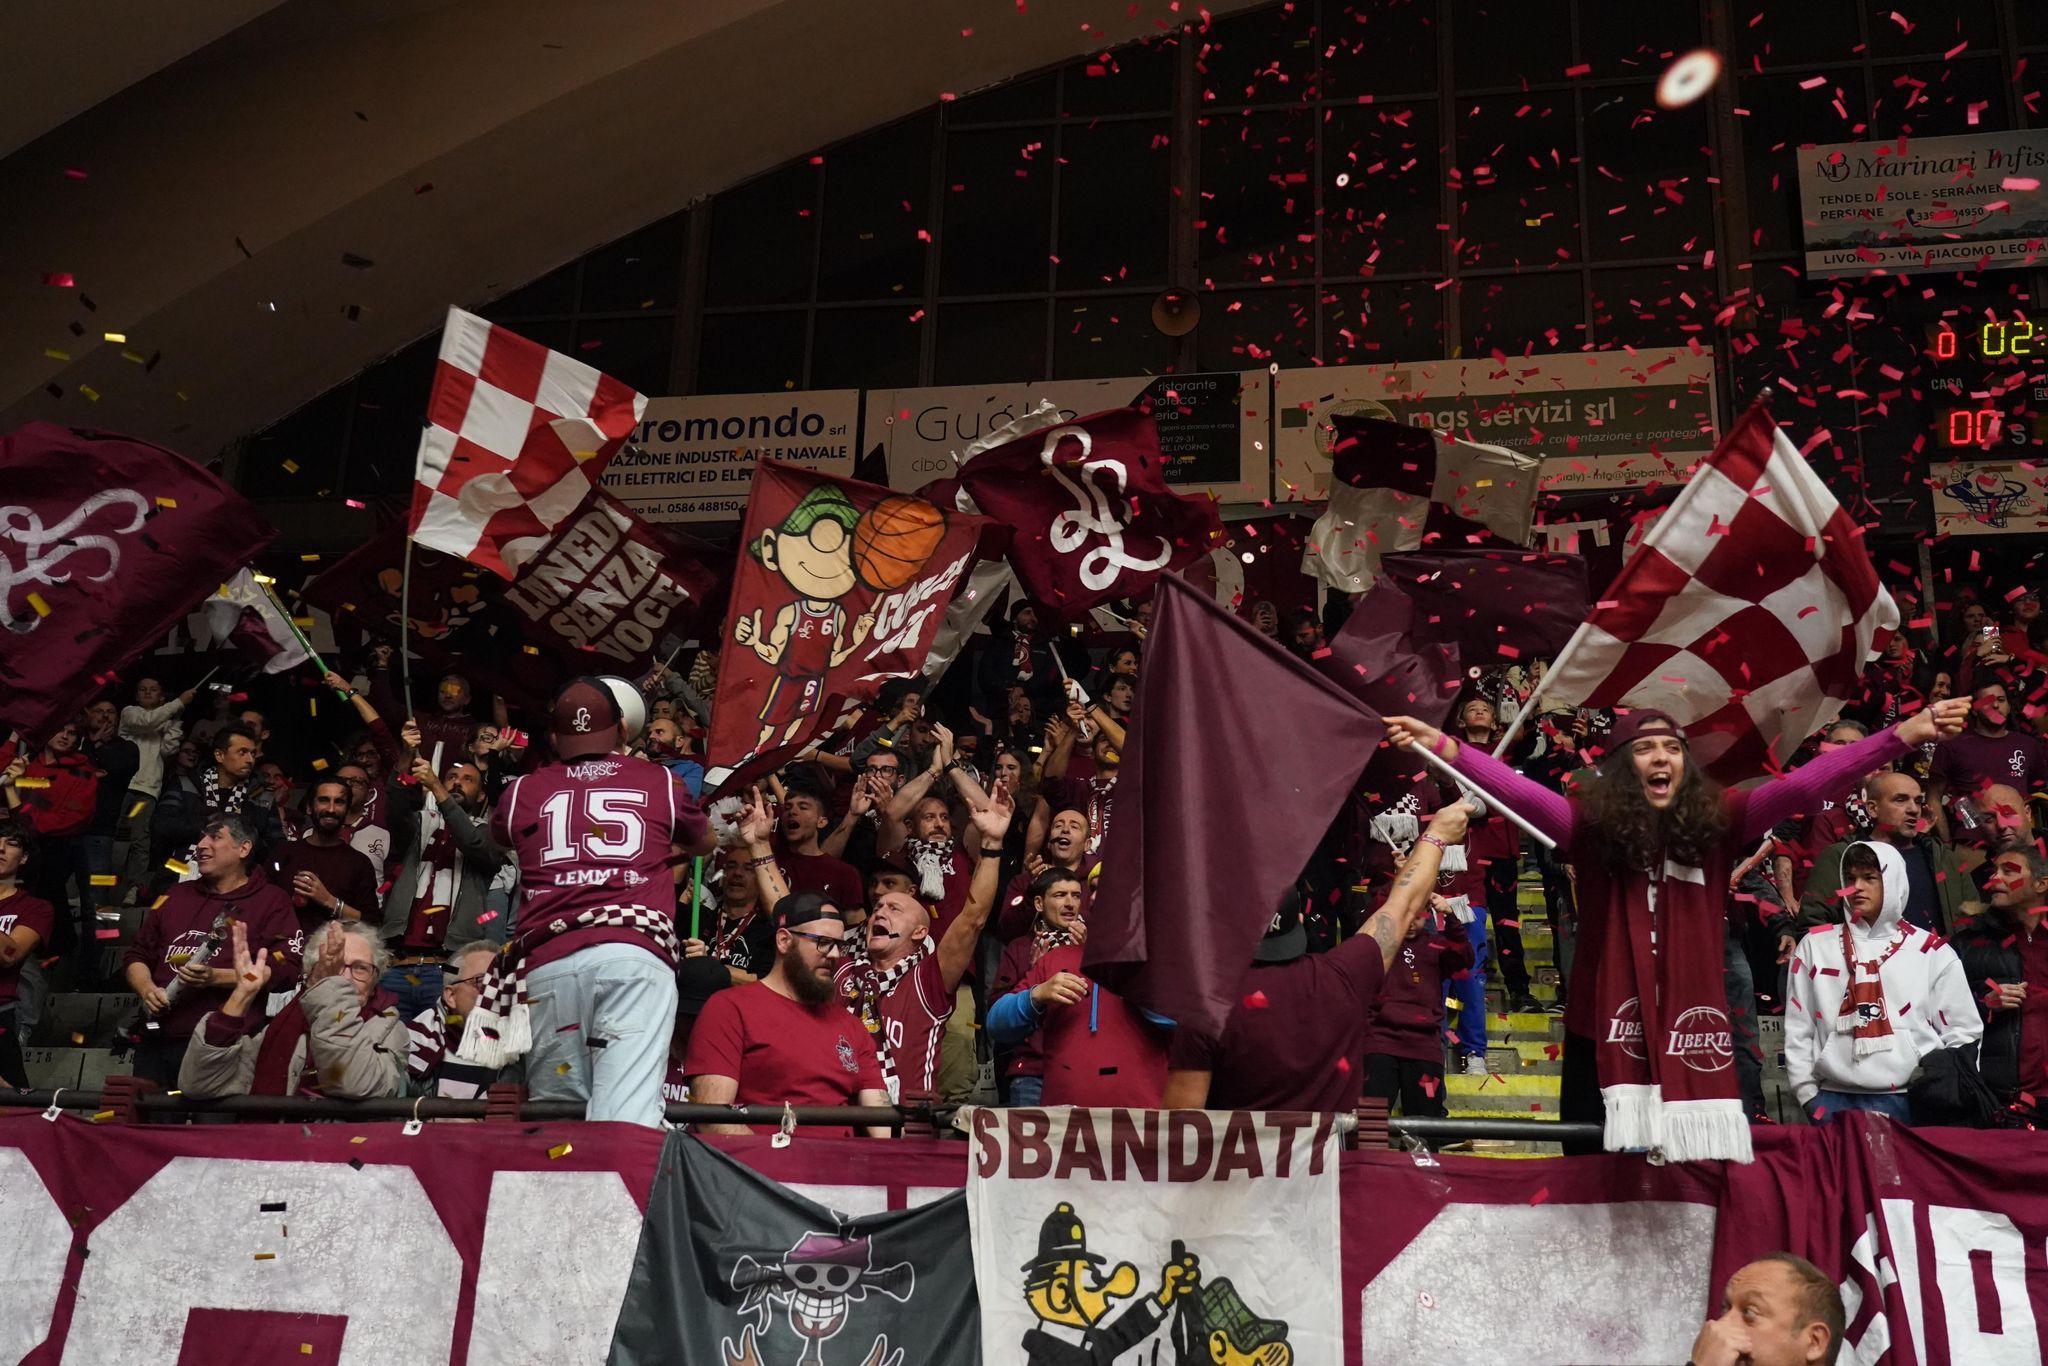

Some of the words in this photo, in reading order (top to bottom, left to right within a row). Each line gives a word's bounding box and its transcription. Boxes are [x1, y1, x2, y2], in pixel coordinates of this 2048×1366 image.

[1855, 151, 1976, 179] Marinari
[1984, 146, 2048, 174] Infis
[1819, 193, 1861, 205] TENDE
[1887, 189, 1920, 201] SOLE
[1820, 208, 1884, 220] PERSIANE
[1898, 247, 1921, 259] VIA
[1928, 242, 1995, 259] GIACOMO
[1158, 379, 1217, 391] ristorante
[1930, 377, 1964, 390] CASA
[1408, 409, 1469, 433] mgs
[1480, 399, 1572, 427] servizi
[1583, 397, 1616, 421] srl
[830, 424, 847, 436] srl
[787, 445, 848, 460] NAVALE
[912, 458, 948, 473] cibo
[625, 469, 695, 486] ELETTRICI
[700, 468, 718, 482] ED
[668, 502, 695, 513] 0586
[698, 501, 738, 513] 488150
[549, 539, 666, 650] SENZA
[595, 573, 690, 663] VOCE
[540, 788, 648, 868] 15
[1666, 1030, 1734, 1057] LIBERTA
[972, 1107, 1336, 1183] SBANDATI
